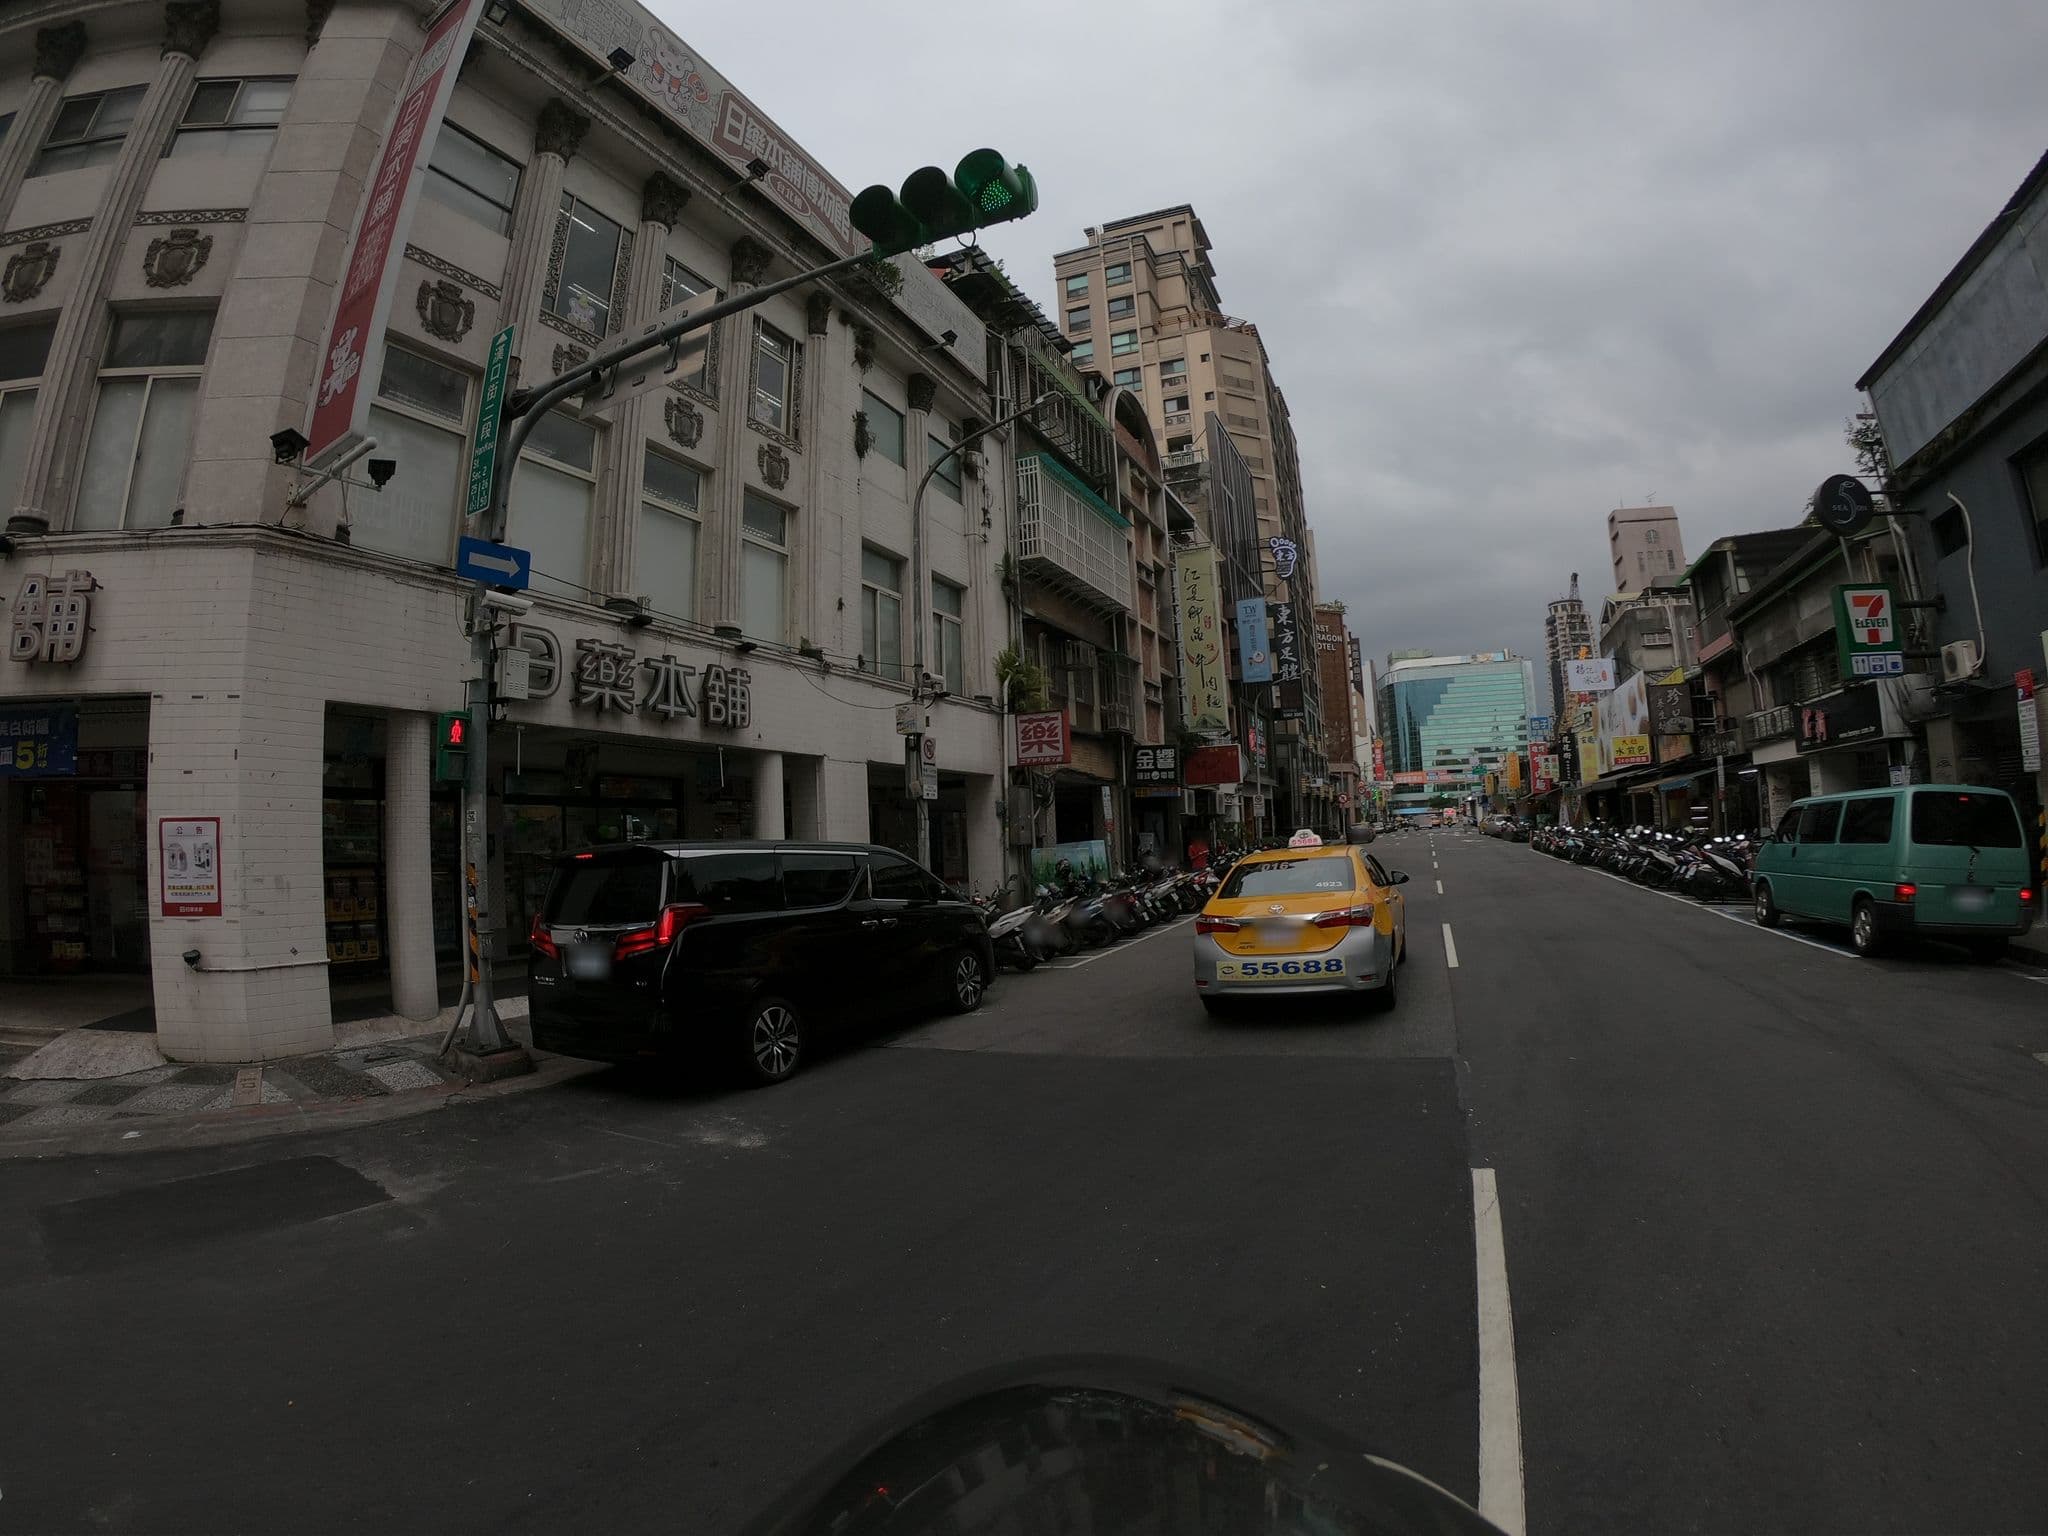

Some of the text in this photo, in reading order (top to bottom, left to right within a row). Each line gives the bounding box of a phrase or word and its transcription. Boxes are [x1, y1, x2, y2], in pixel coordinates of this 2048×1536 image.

[481, 343, 504, 440] 漢口街二段
[1019, 716, 1060, 753] 藥
[1242, 959, 1343, 975] 55688
